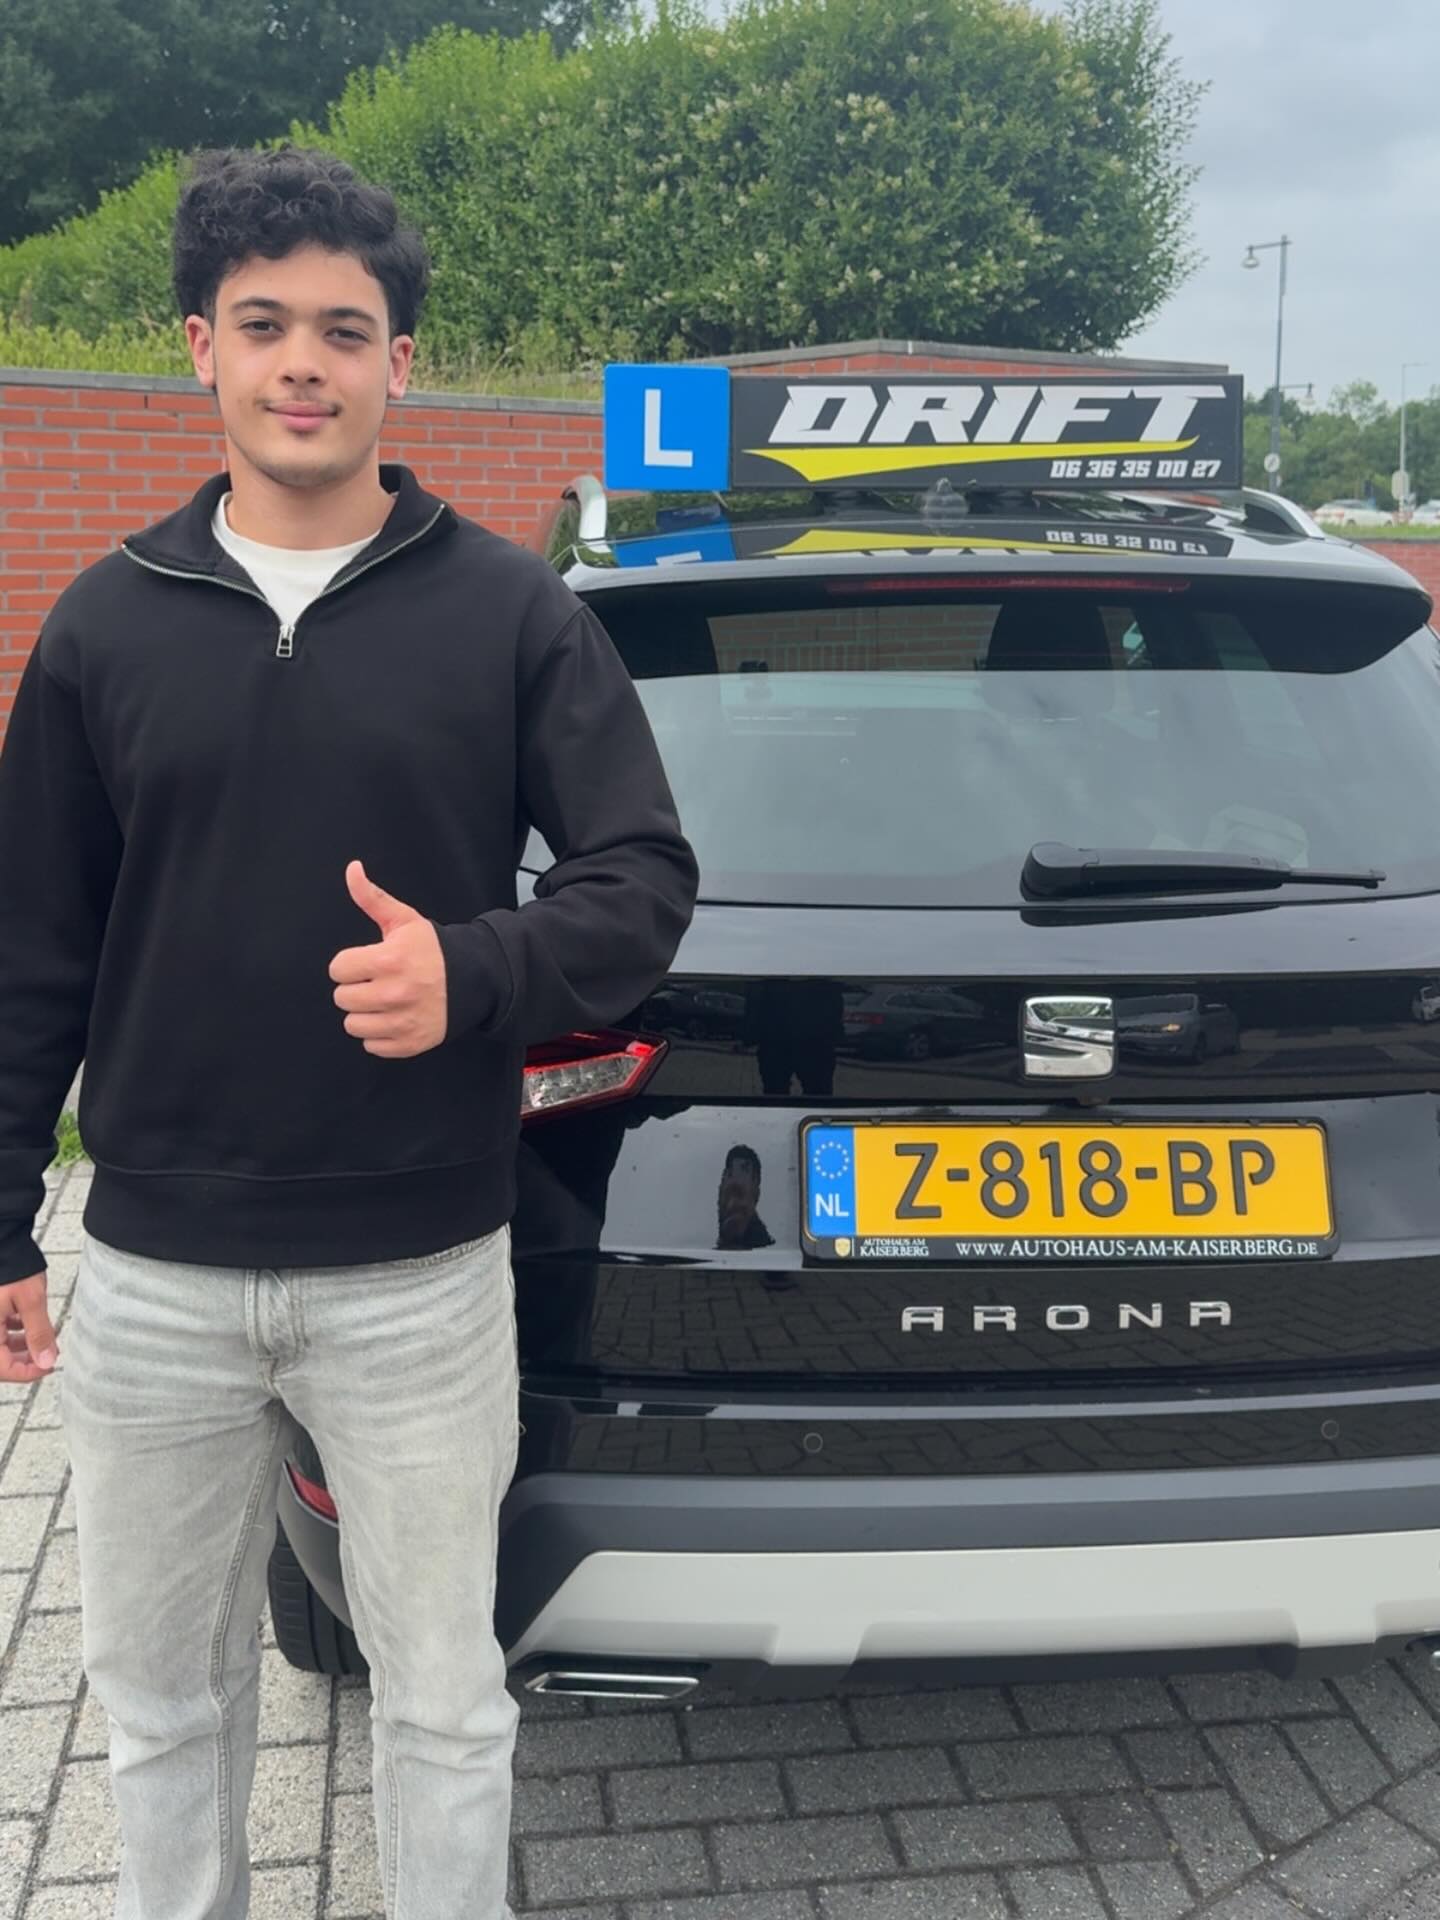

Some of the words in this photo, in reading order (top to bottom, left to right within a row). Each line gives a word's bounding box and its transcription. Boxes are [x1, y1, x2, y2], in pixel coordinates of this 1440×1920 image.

[643, 388, 693, 467] L
[768, 385, 1227, 444] DRIFT
[1050, 459, 1082, 478] 06
[1085, 459, 1117, 478] 36
[1120, 459, 1152, 478] 35
[1156, 459, 1188, 478] 00
[1191, 459, 1222, 478] 27
[894, 1138, 1275, 1220] Z-818-BP
[815, 1193, 849, 1217] NL
[860, 1245, 930, 1257] KAISERBERG
[863, 1238, 910, 1246] AUTOHAUS
[912, 1238, 926, 1246] AM
[902, 1301, 1232, 1332] ARONA
